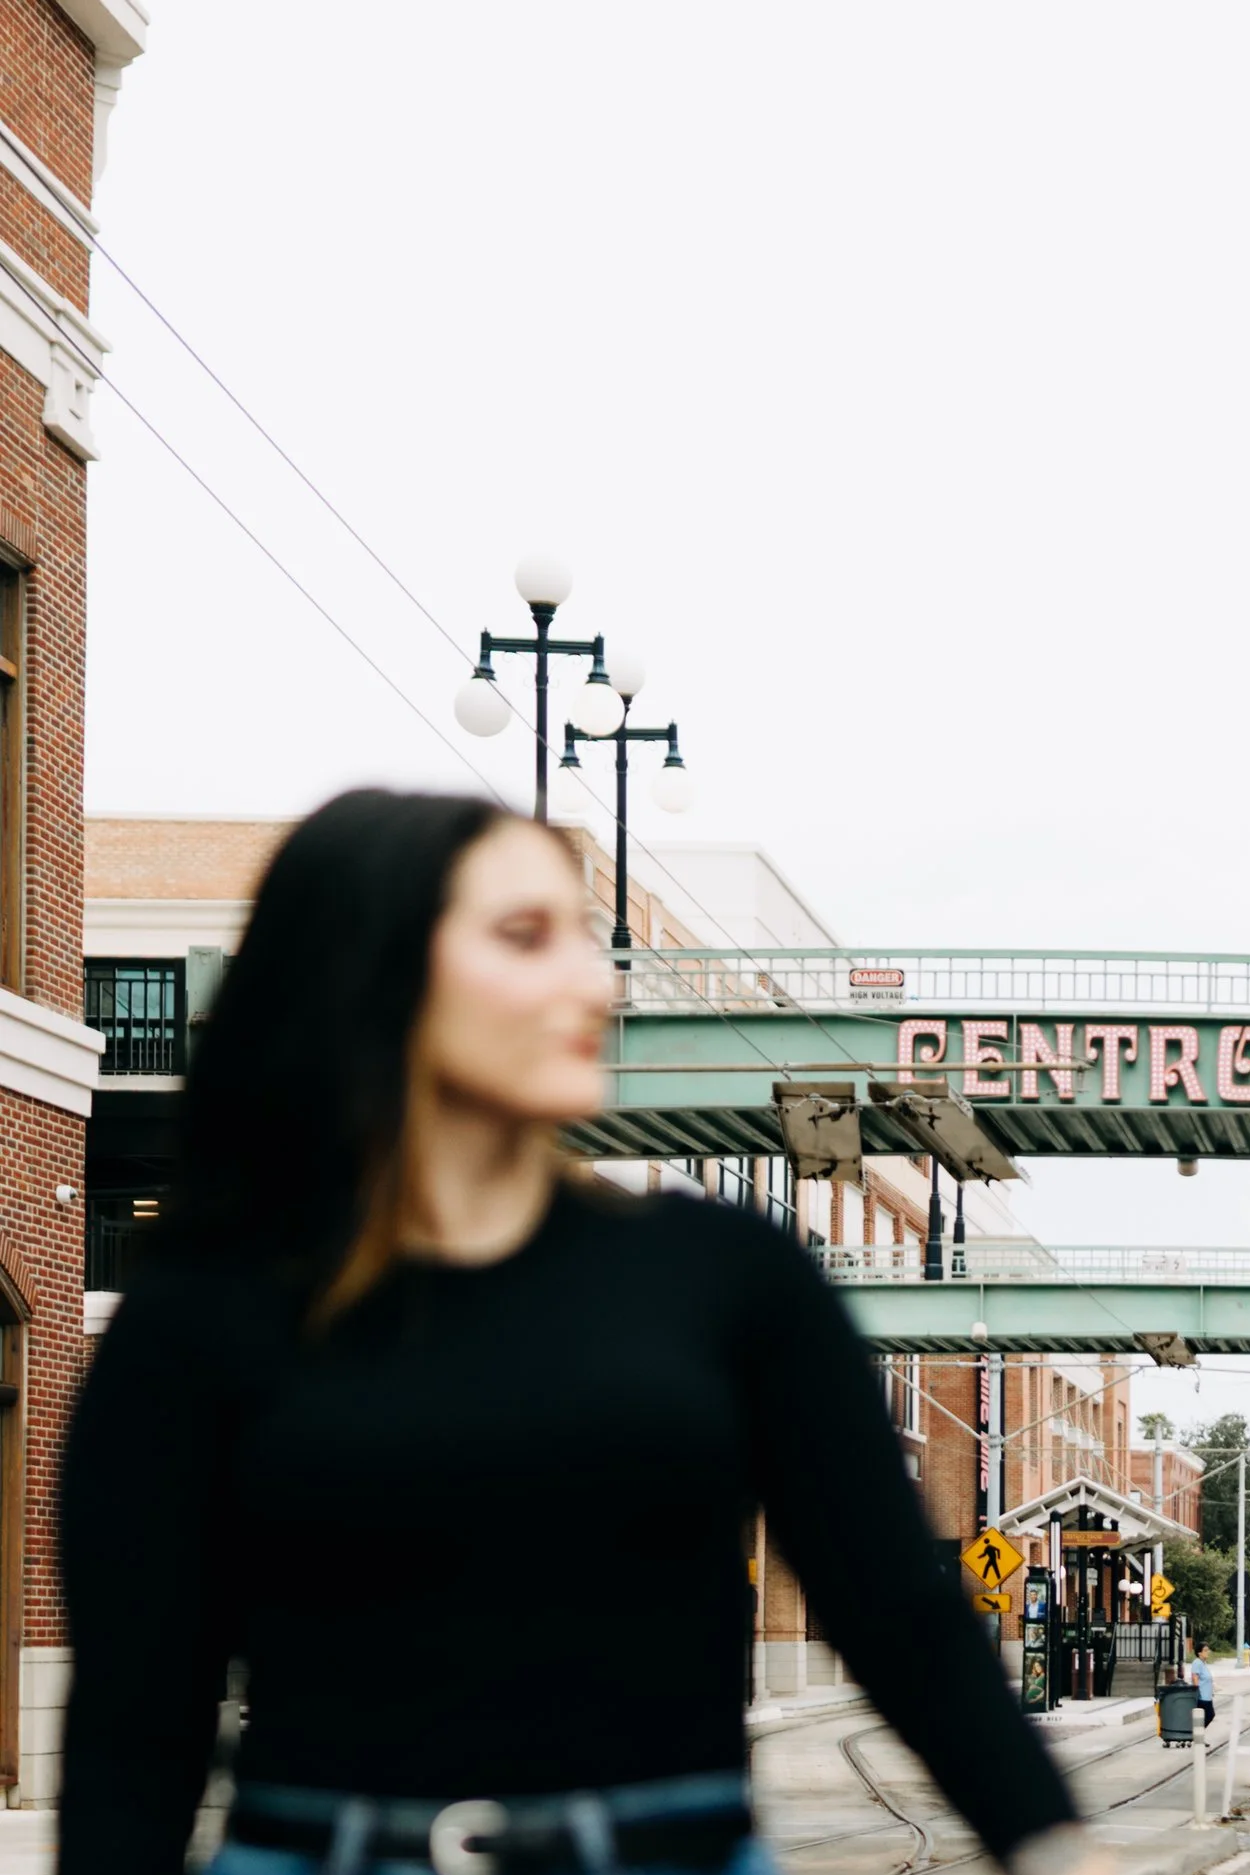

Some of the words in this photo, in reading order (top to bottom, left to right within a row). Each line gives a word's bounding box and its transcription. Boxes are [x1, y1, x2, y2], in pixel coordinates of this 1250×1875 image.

[854, 971, 900, 983] DANGER
[850, 991, 868, 999] HIGH
[872, 991, 903, 999] VOLTAGE
